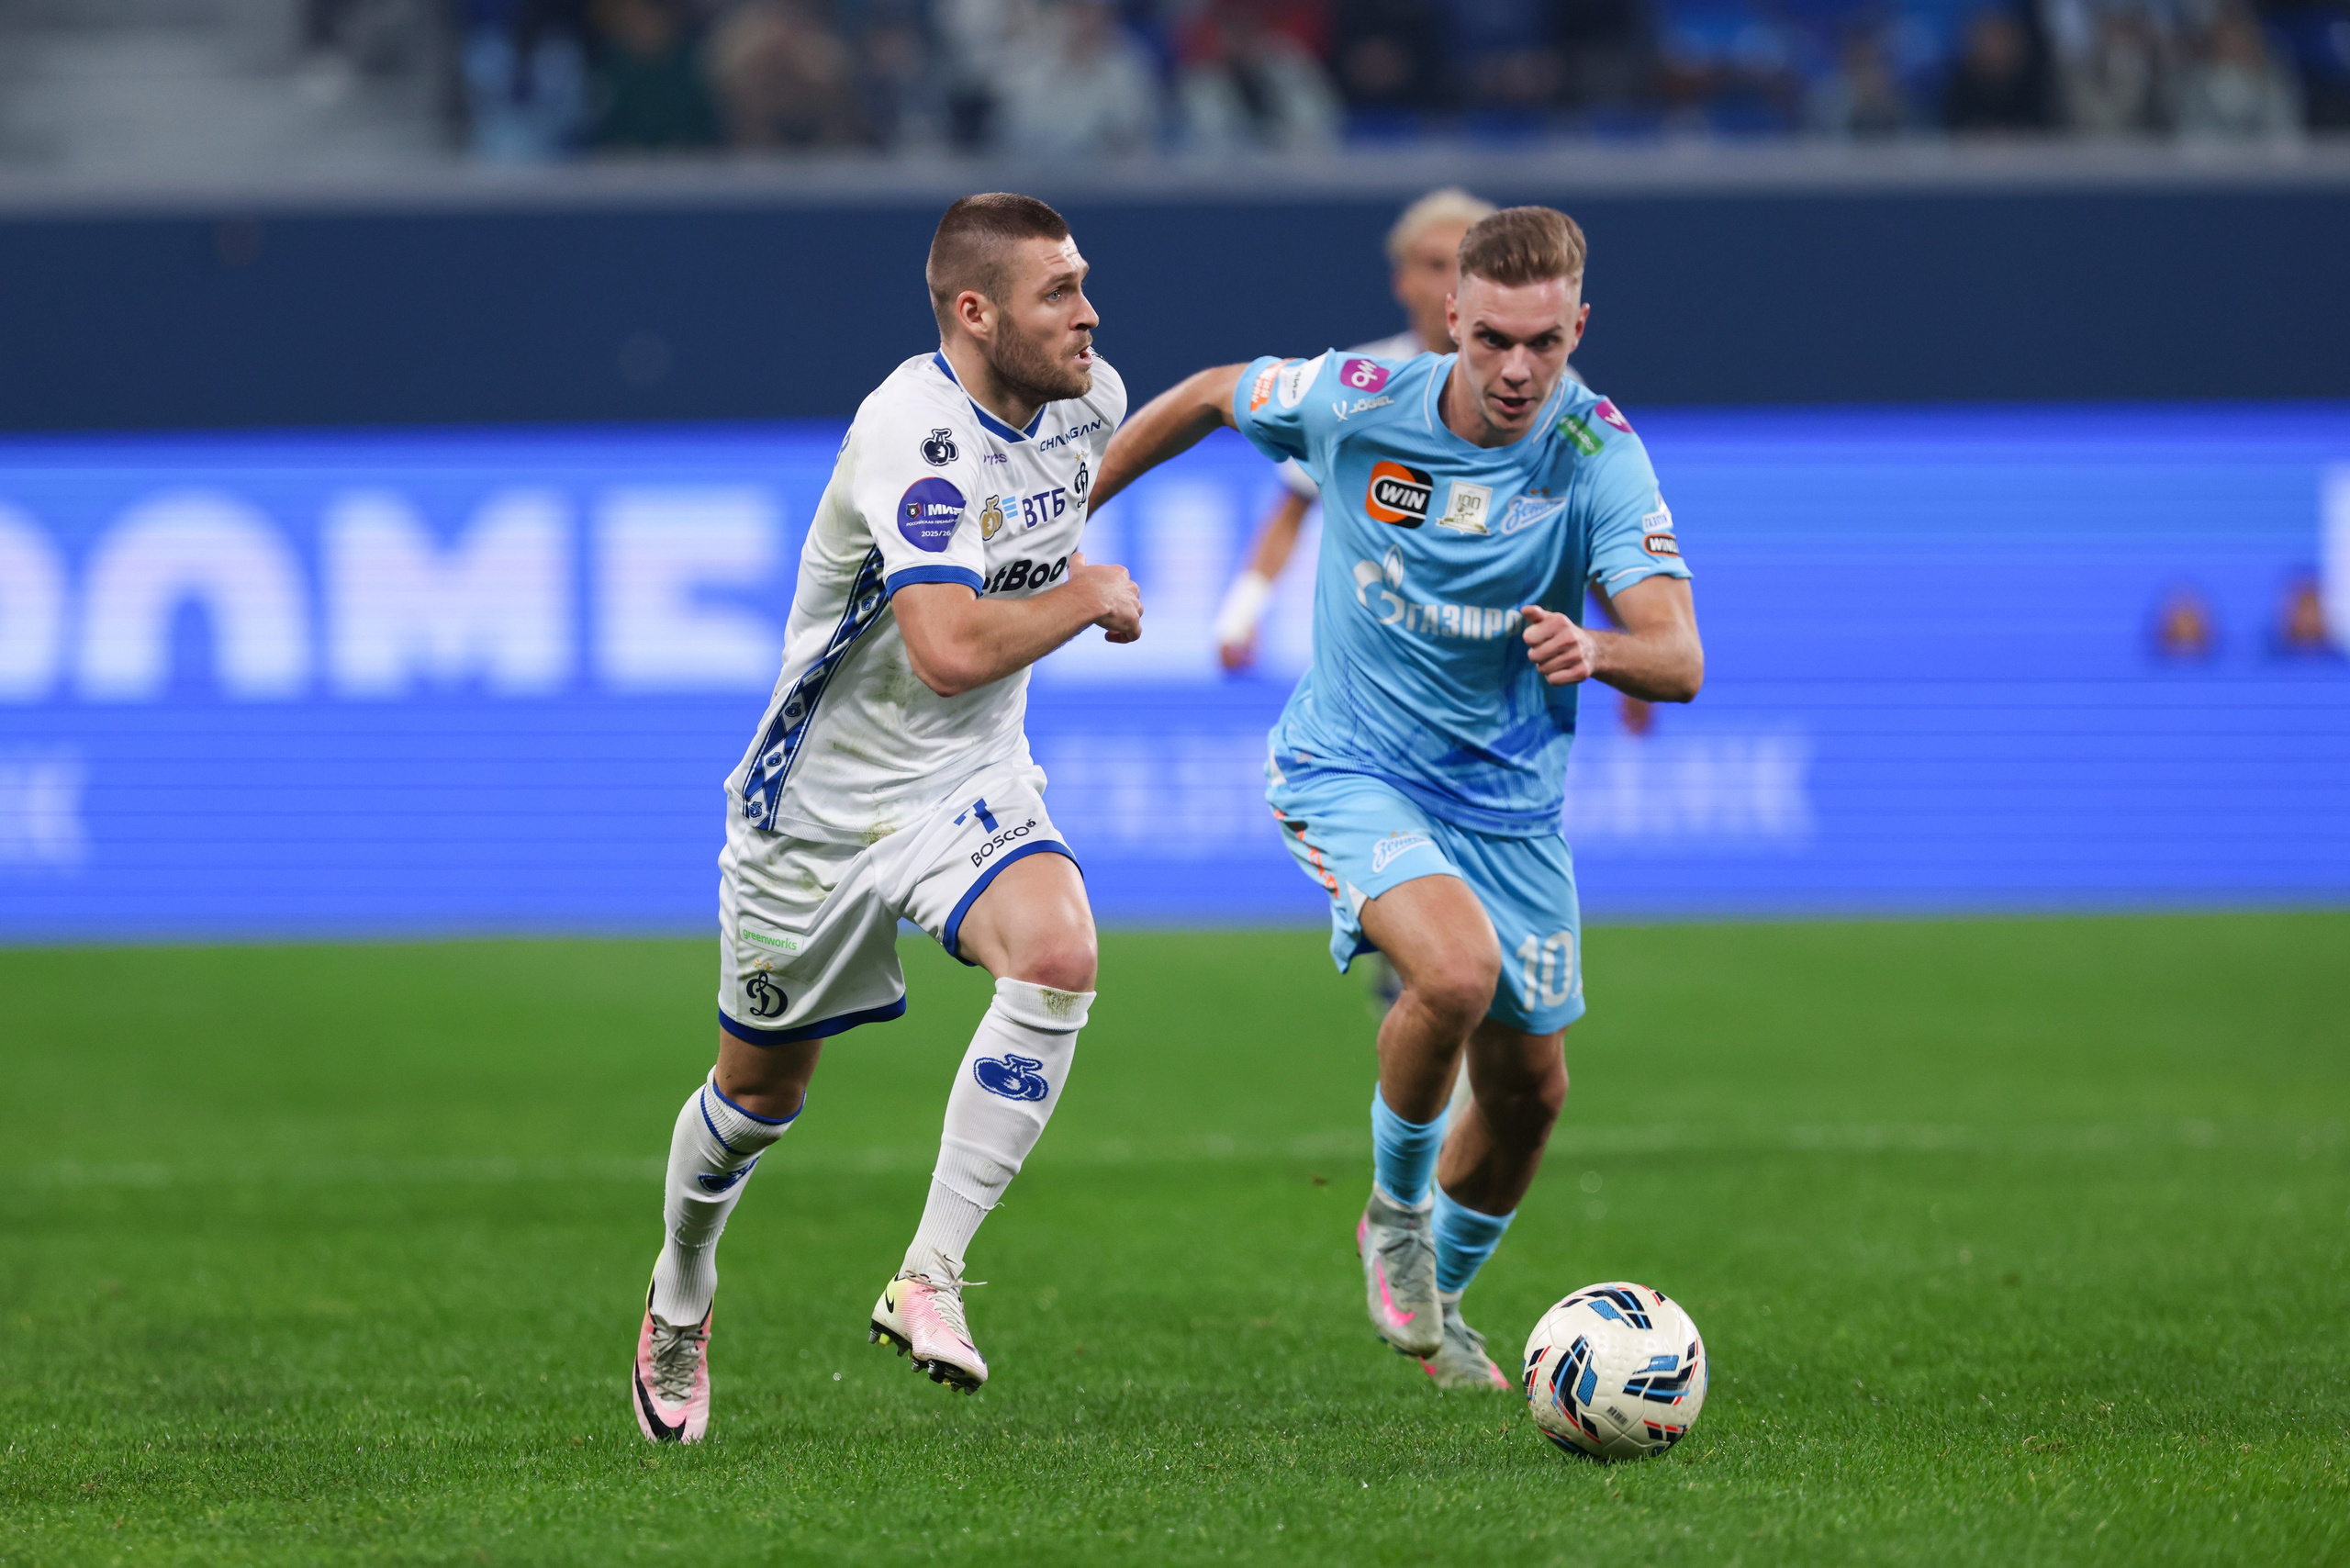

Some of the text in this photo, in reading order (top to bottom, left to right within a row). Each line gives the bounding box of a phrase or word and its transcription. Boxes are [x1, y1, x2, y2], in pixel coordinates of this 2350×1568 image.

[1039, 419, 1102, 453] CHANGAN
[1022, 487, 1067, 529] ВТБ
[1381, 482, 1427, 510] WIN
[921, 530, 952, 538] 2025/26
[970, 825, 1030, 868] BOSCO
[743, 928, 798, 951] greenworks
[1516, 930, 1574, 1013] 10
